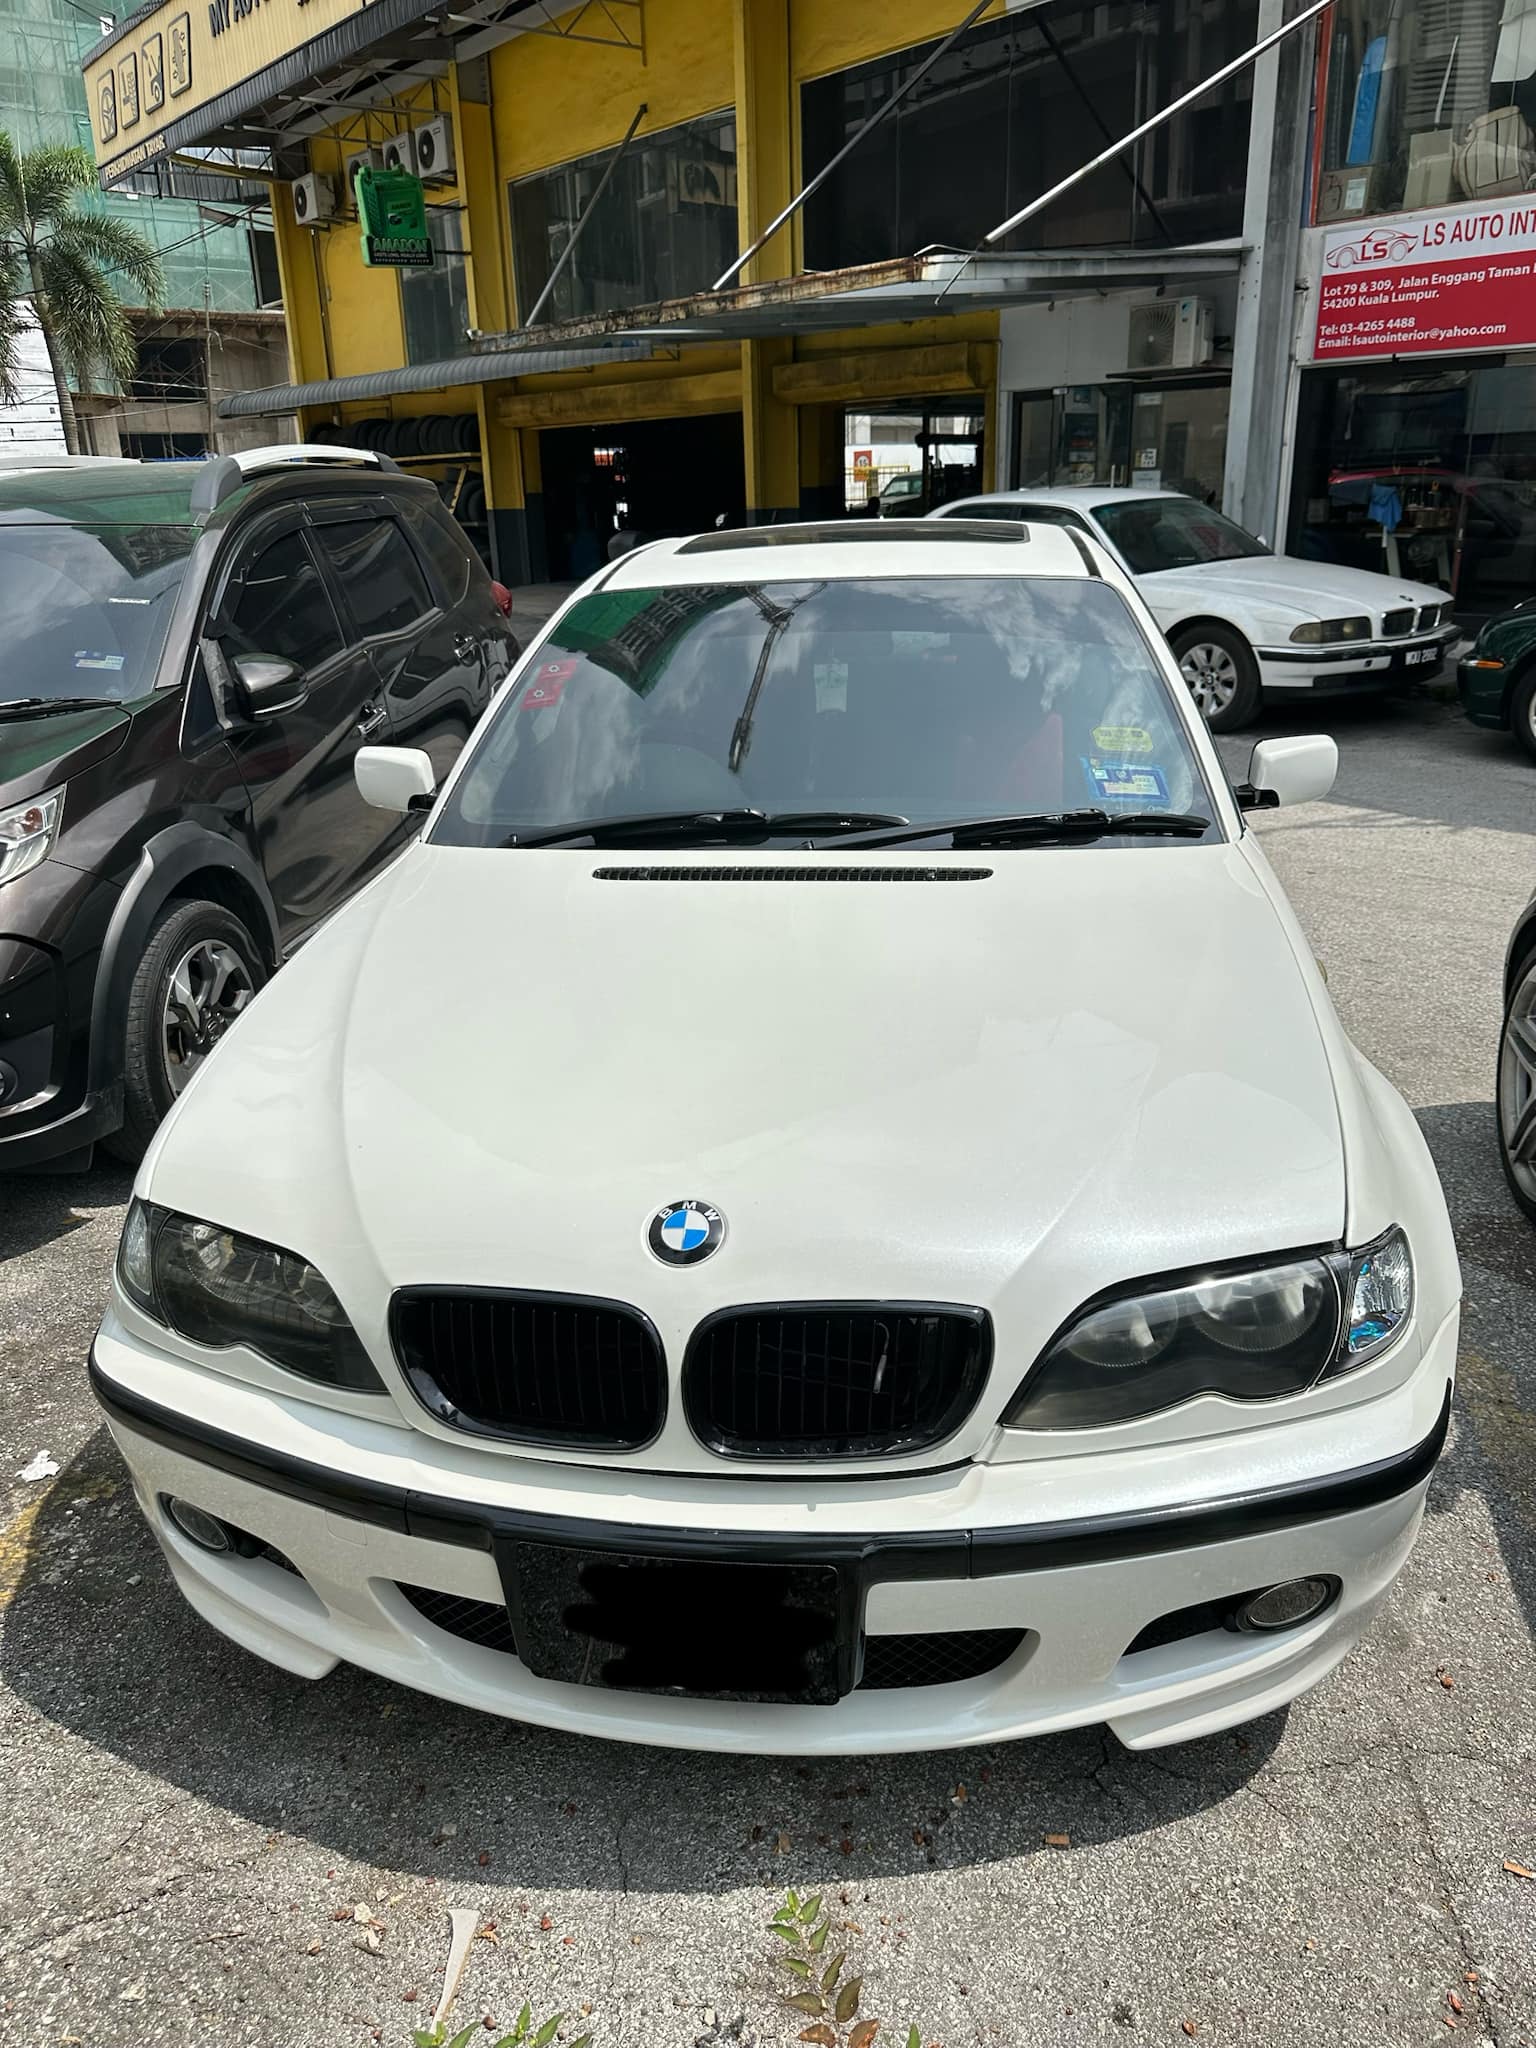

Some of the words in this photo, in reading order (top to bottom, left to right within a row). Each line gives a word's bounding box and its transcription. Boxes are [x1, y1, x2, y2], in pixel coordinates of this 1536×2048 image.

[1422, 222, 1447, 247] LS
[1450, 214, 1505, 244] AUTO
[373, 238, 428, 252] AMARON
[1360, 242, 1388, 261] LS
[1323, 285, 1342, 297] Lot
[1343, 283, 1358, 295] 79
[1358, 281, 1368, 293] &
[1369, 279, 1394, 291] 309,
[1398, 276, 1429, 289] Jalan
[1431, 270, 1486, 286] Enggang
[1488, 265, 1531, 278] Taman
[1322, 297, 1357, 310] 54200
[1358, 293, 1389, 306] Kuala
[1391, 288, 1440, 302] Lumpur.
[1318, 335, 1352, 349] Email:
[1352, 324, 1507, 346] lsautointerior@yahoo.com
[1320, 324, 1339, 336] Tel:
[1339, 320, 1385, 334] 03-4265
[1386, 317, 1416, 329] 4488
[658, 1201, 720, 1221] BMW
